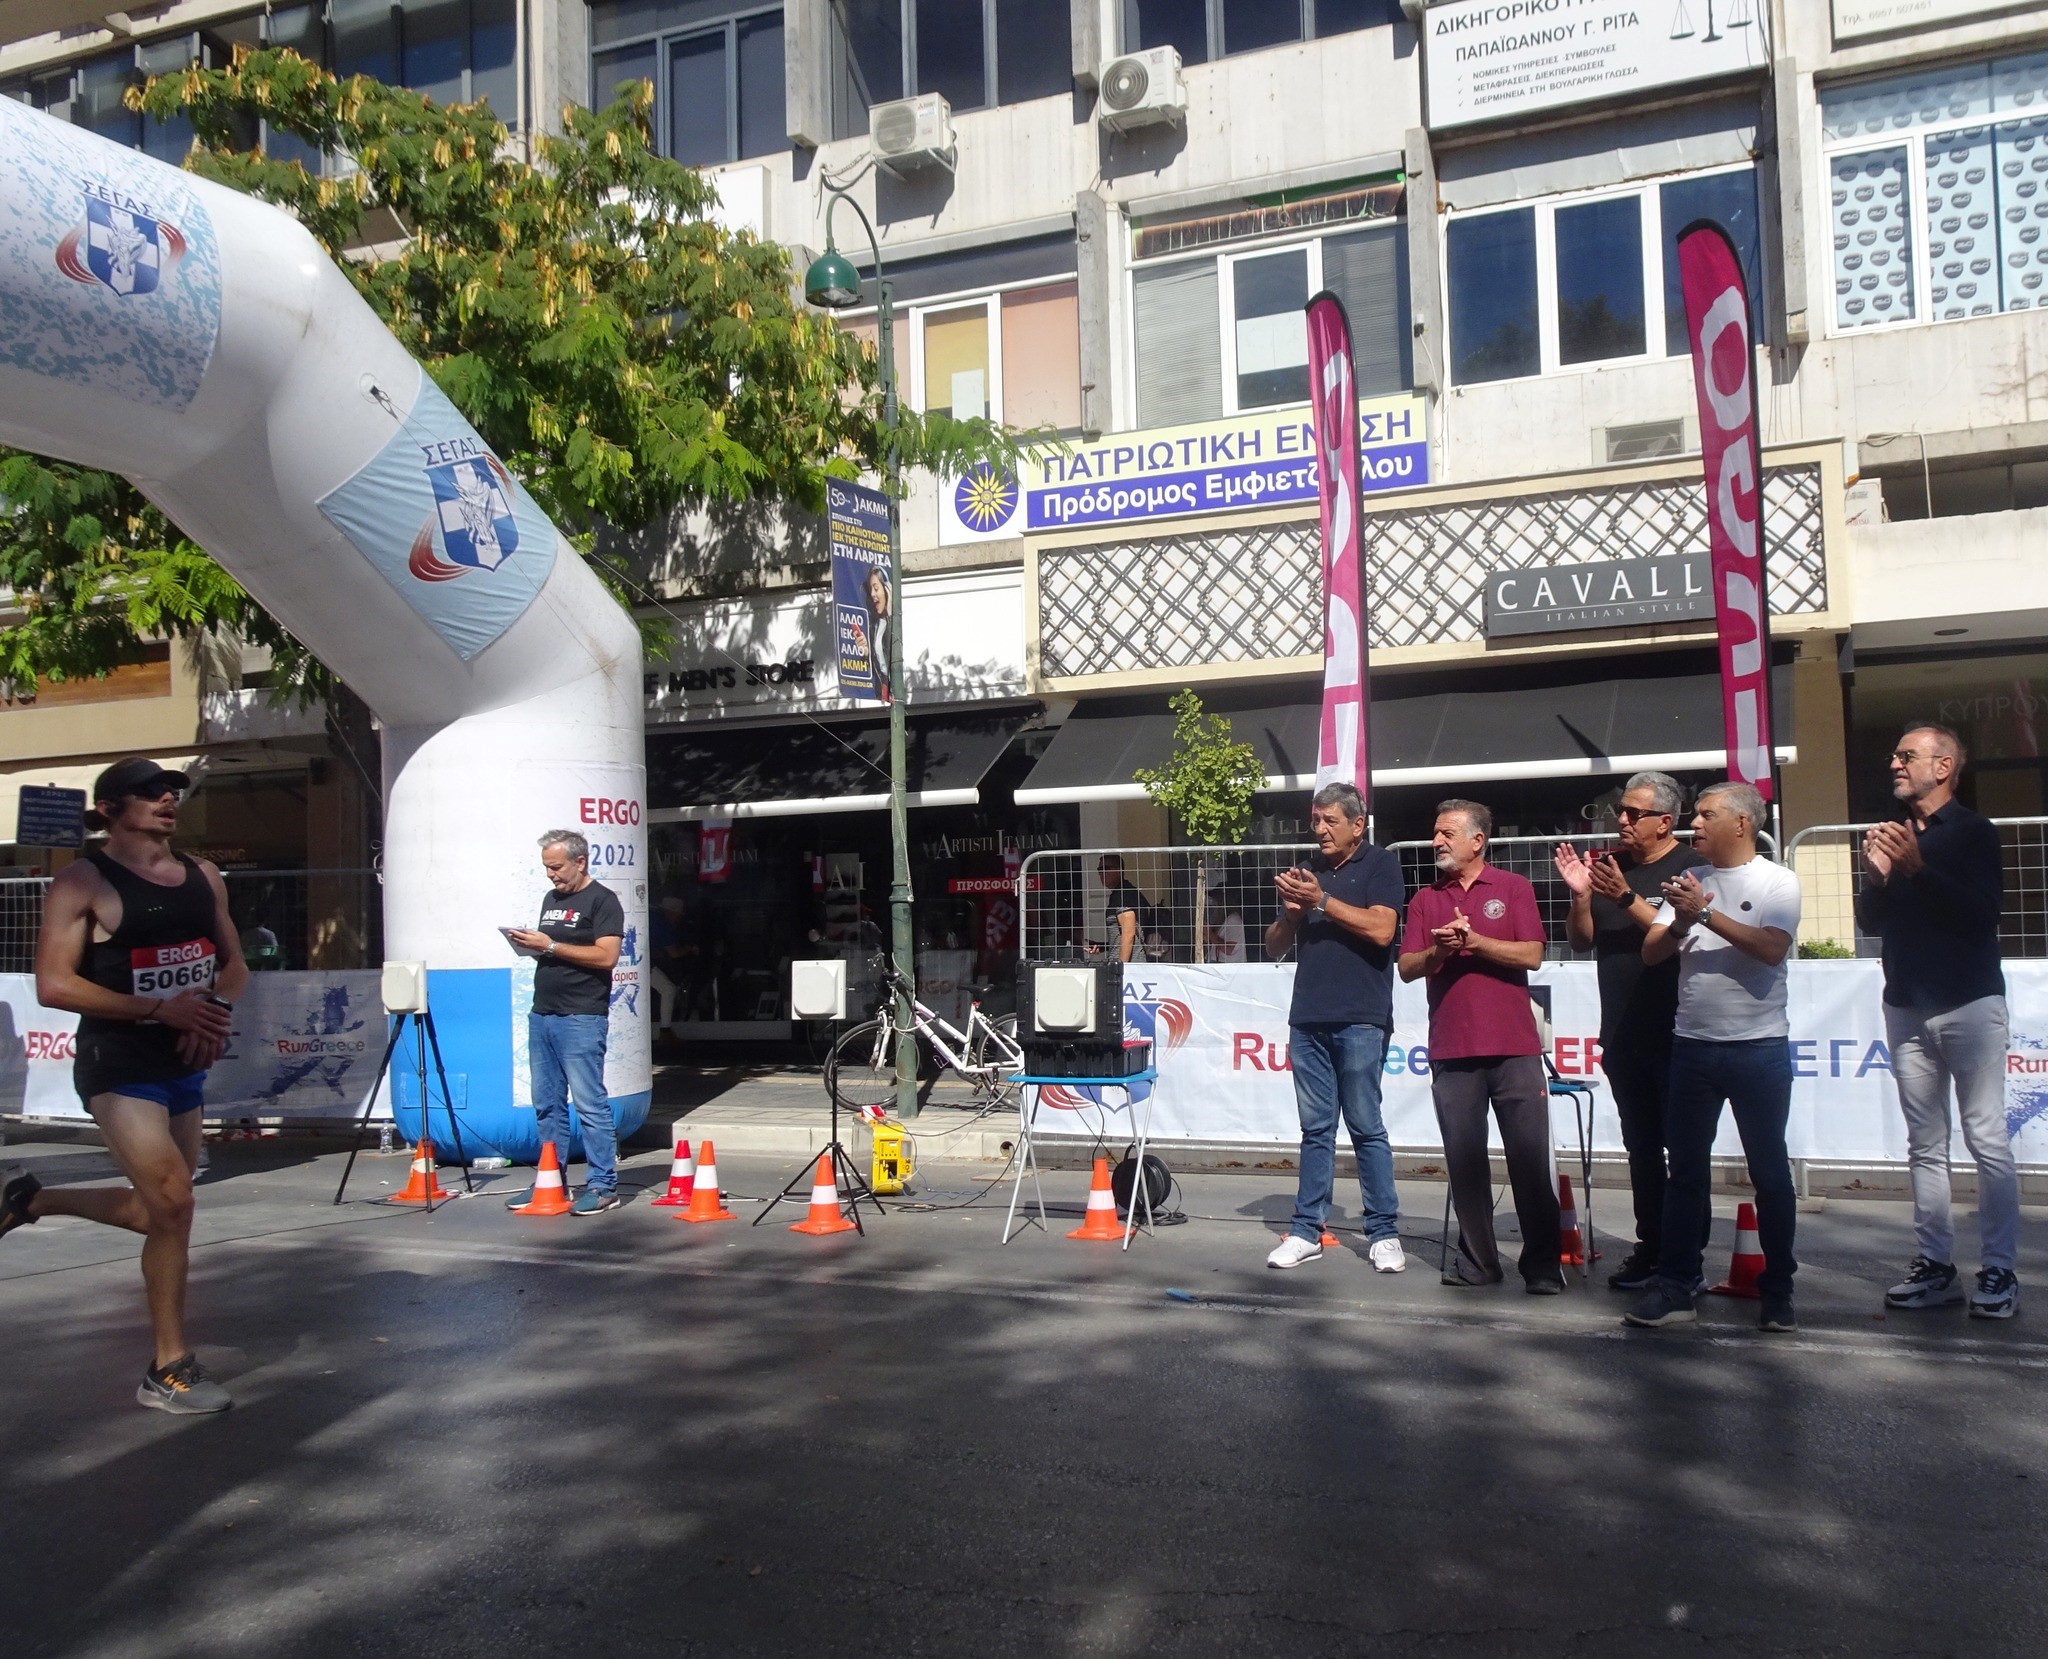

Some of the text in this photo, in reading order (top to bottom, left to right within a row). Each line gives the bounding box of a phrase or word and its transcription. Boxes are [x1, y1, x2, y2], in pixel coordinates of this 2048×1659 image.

[1455, 11, 1640, 62] ΠΑΠΑΪΩΑΝΝΟΥ Γ. ΡΙΤΑ
[1473, 65, 1511, 80] ΝΟΜΙΚΕΣ
[1512, 54, 1559, 72] ΥΠΗΡΕΣΙΕΣ
[1535, 60, 1605, 81] ΔΙΕΚΠΕΡΑΙΩΣΕΙΣ
[1474, 66, 1639, 106] ΔΙΕΡΜΗΝΕΙΑ ΣΤΗ ΒΟΥΛΓΑΡΙΚΗ ΓΛΩΣΣΑ
[81, 179, 155, 219] ΣΕΓΑΣ
[420, 437, 482, 467] ΣΕΓΑΣ
[1044, 409, 1412, 484] ΠΑΤΡΙΩΤΙΚΗ ΕΝΣΗ
[859, 498, 888, 518] ΑΚΜΗ
[1044, 481, 1197, 521] Πρόδρομος
[832, 520, 888, 544] ΠΙΟ ΚΑΙΝΟΤΟΜΟ
[832, 531, 891, 554] ΙΕΚ ΤΗΣ ΕΥΡΩΠΗΣ
[832, 542, 893, 569] ΣΤΗ ΛΑΡΙΣΑ
[1496, 563, 1703, 611] CAVALL
[1546, 601, 1697, 623] ITALIAN STYLE
[841, 643, 865, 657] ΑΛΛΟ
[668, 666, 736, 693] MEN'S
[745, 660, 815, 687] STORE
[580, 797, 641, 826] ERGO
[590, 844, 635, 866] 2022
[934, 828, 1059, 860] ARTISTI ITALIANI
[956, 878, 1035, 892] ΠΡΟΣΦΟΡΣ
[157, 942, 203, 965] ERGO
[138, 959, 212, 993] 50663
[611, 969, 639, 984] άρισα
[277, 1037, 365, 1054] RunGreece
[1789, 1039, 1896, 1078] ΕΓΑ
